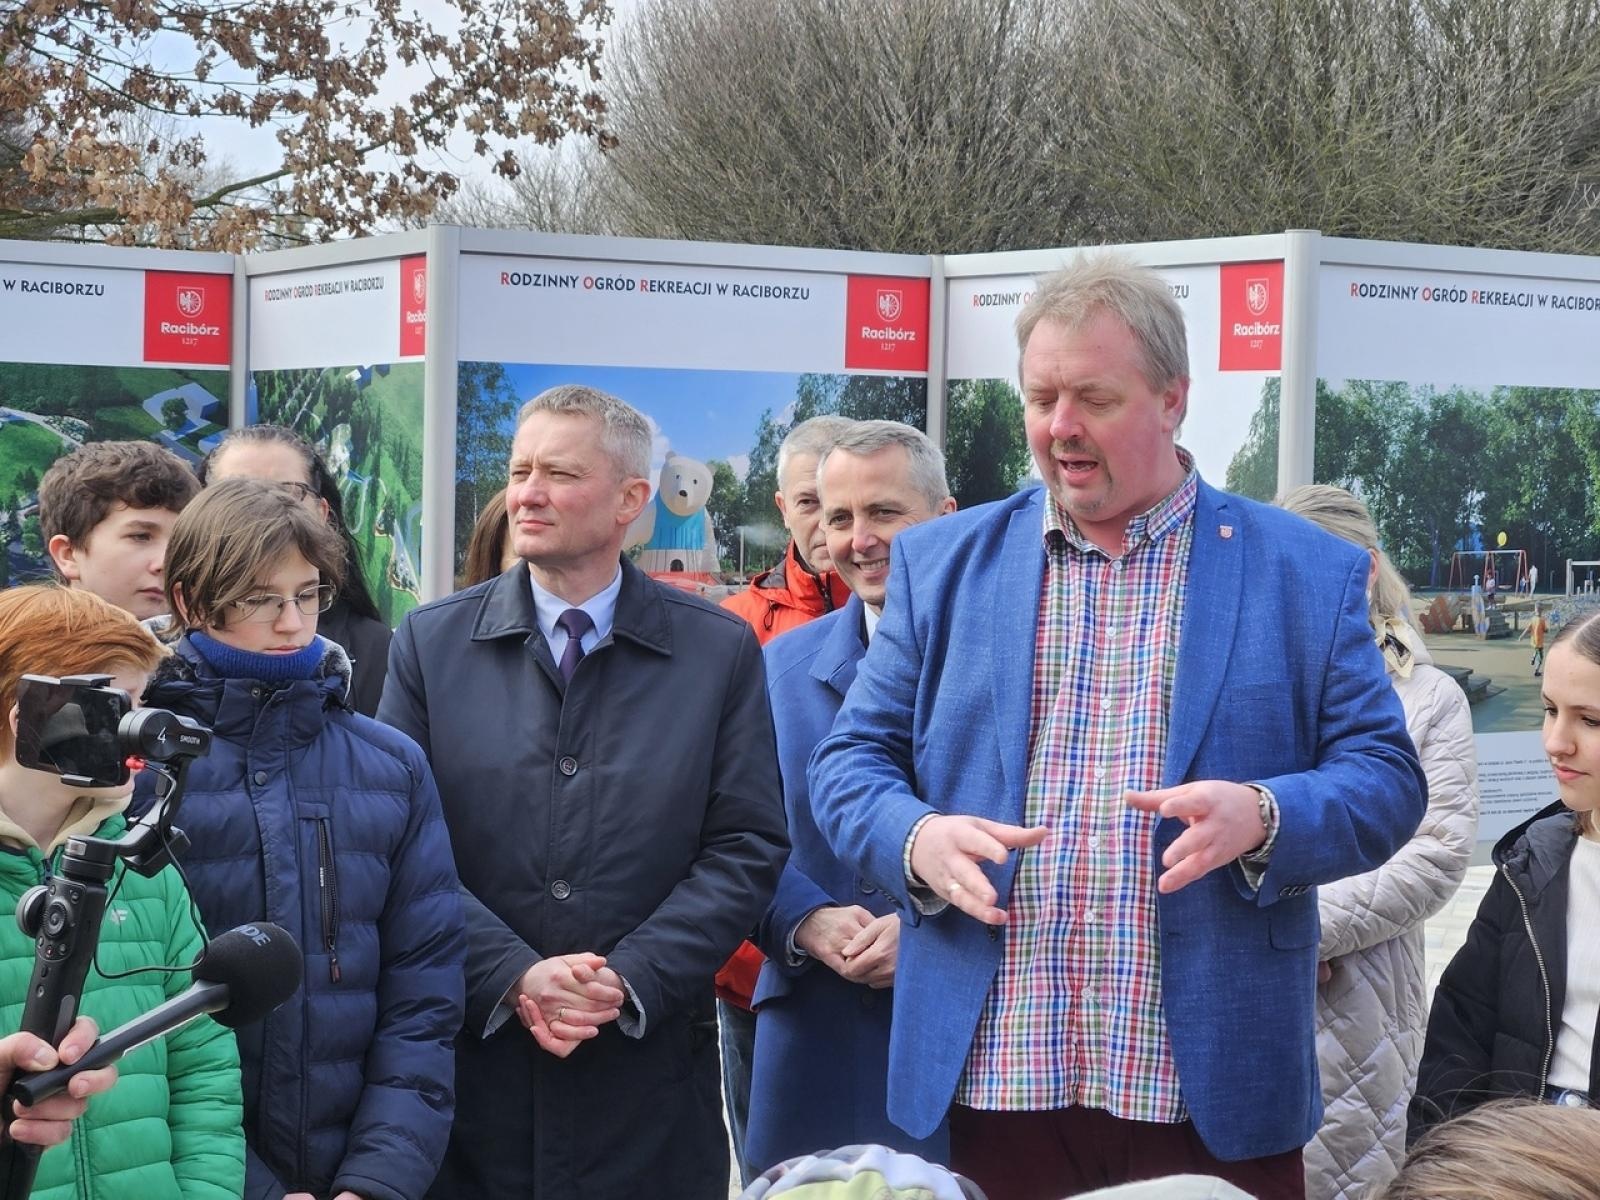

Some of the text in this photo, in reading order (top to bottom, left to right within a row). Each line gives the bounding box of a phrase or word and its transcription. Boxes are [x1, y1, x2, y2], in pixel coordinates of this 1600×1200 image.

[3, 279, 105, 297] W RACIBORZU
[500, 272, 810, 300] RODZINNY OGRÓD REKREACJI W RACIBORZU
[973, 292, 1022, 307] RODZINNY
[1350, 282, 1420, 301] RODZINNY
[1422, 285, 1468, 303] OGRÓD
[1471, 290, 1533, 308] REKREACJI
[1537, 295, 1548, 307] W
[161, 321, 220, 336] Racibórz
[862, 326, 916, 341] Racibórz
[1233, 321, 1280, 336] Racibórz
[157, 726, 166, 744] 4
